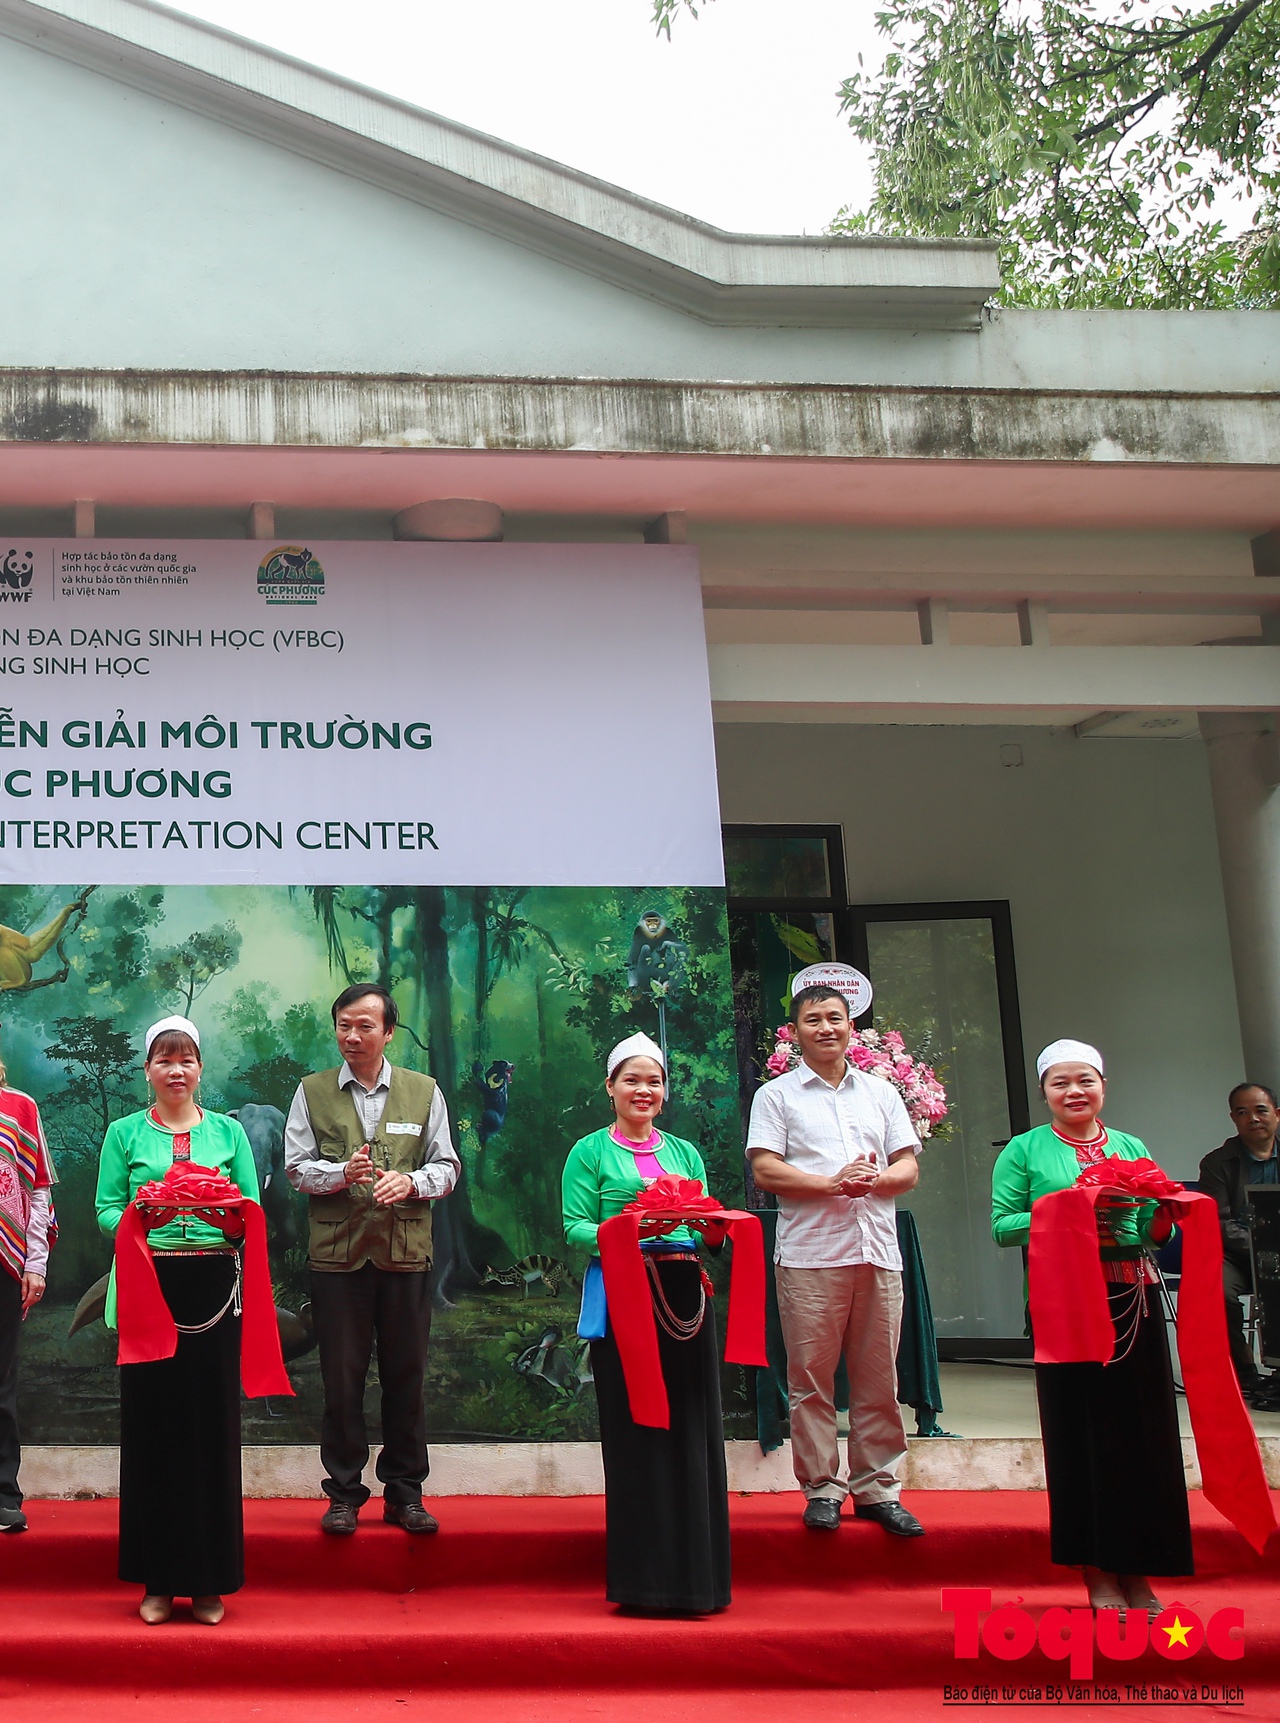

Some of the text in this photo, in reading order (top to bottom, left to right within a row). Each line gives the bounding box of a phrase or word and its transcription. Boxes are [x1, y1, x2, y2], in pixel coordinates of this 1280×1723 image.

[62, 552, 177, 562] Hợp tác bảo tồn đa dạng
[61, 563, 197, 574] sinh học ở các vườn quốc gia
[61, 574, 189, 585] và khu bảo tồn thiên nhiên
[61, 587, 120, 597] tại Việt Nam
[257, 583, 325, 595] CÚC PHƯƠNG
[26, 629, 63, 646] ĐA
[70, 629, 141, 649] DẠNG
[149, 629, 202, 647] SINH
[210, 629, 265, 651] HỌC
[273, 631, 344, 653] (VFBC)
[33, 657, 87, 675] SINH
[95, 657, 150, 679] HỌC
[61, 709, 146, 749] GIẢI
[160, 715, 238, 749] MÔI
[251, 714, 432, 750] TRƯỜNG
[46, 768, 232, 799] PHƯƠNG
[296, 821, 440, 850] CENTER
[827, 979, 845, 987] NHÂN
[846, 979, 860, 987] DÂN
